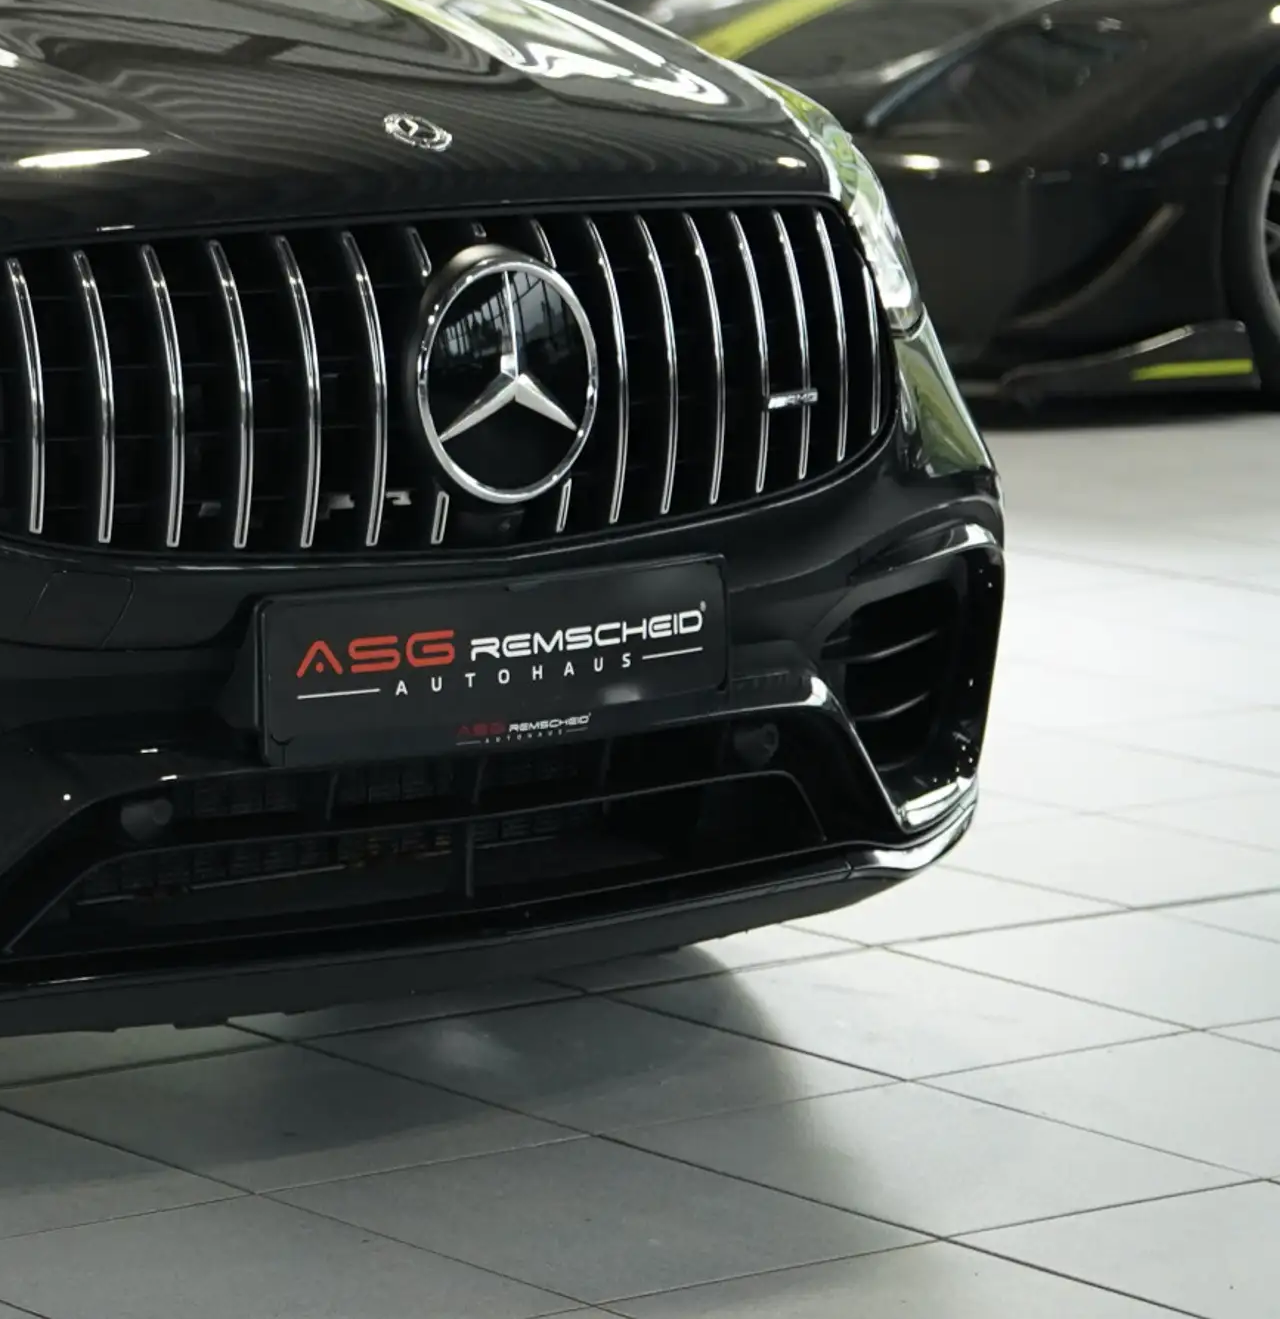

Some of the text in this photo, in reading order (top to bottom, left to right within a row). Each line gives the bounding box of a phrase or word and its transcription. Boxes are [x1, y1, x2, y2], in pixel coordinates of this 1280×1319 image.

[296, 609, 704, 678] ASG REMSCHEID
[395, 652, 632, 697] AUTOHAUS
[509, 715, 589, 732] REMSCHEID
